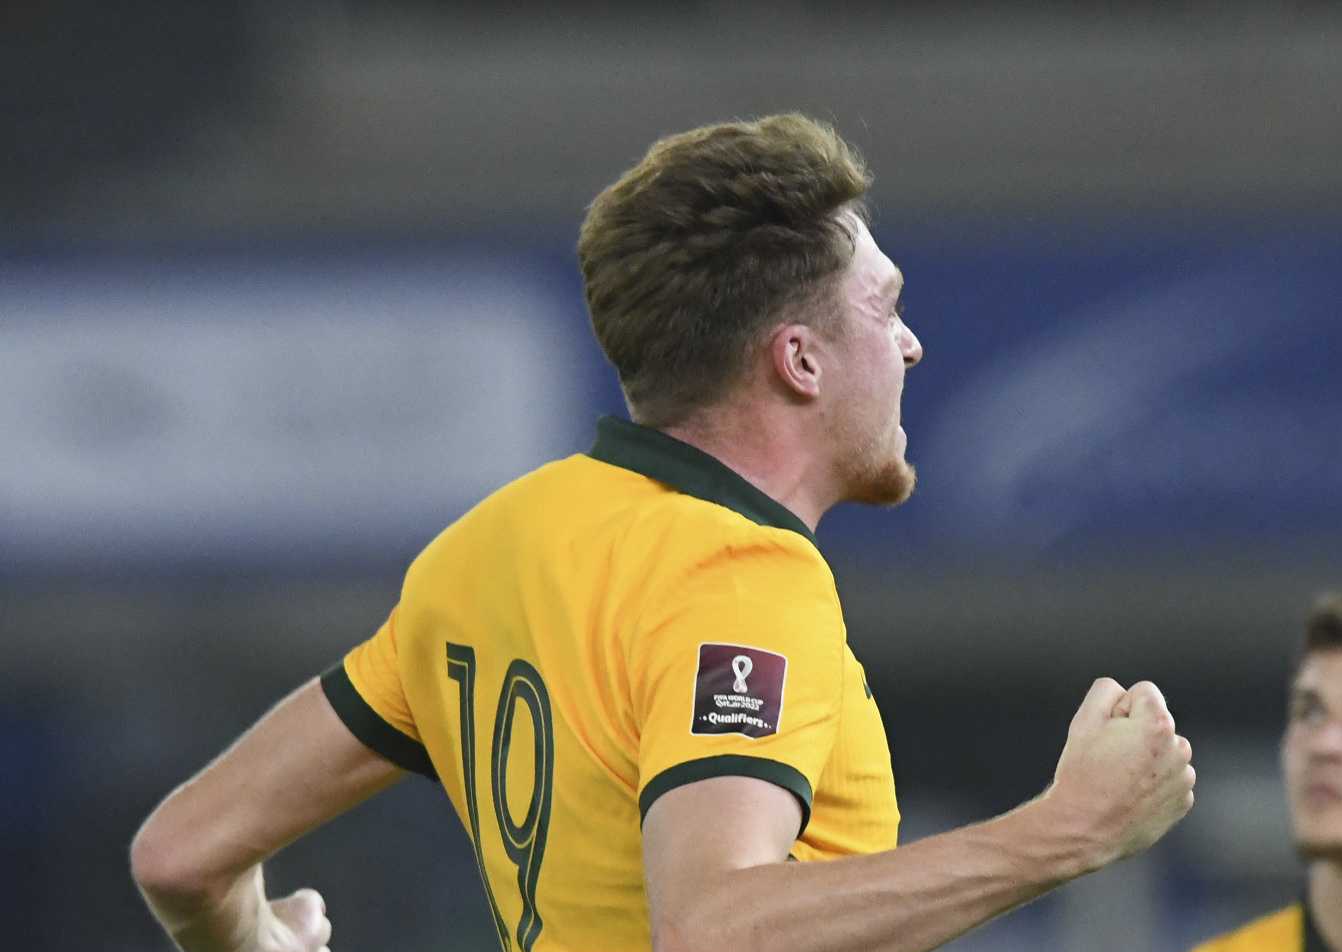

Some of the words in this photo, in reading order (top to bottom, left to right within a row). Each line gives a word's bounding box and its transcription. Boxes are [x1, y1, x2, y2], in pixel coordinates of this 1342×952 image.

[728, 694, 751, 703] WORLD
[751, 698, 764, 706] CUP
[708, 712, 764, 728] Qualifiers
